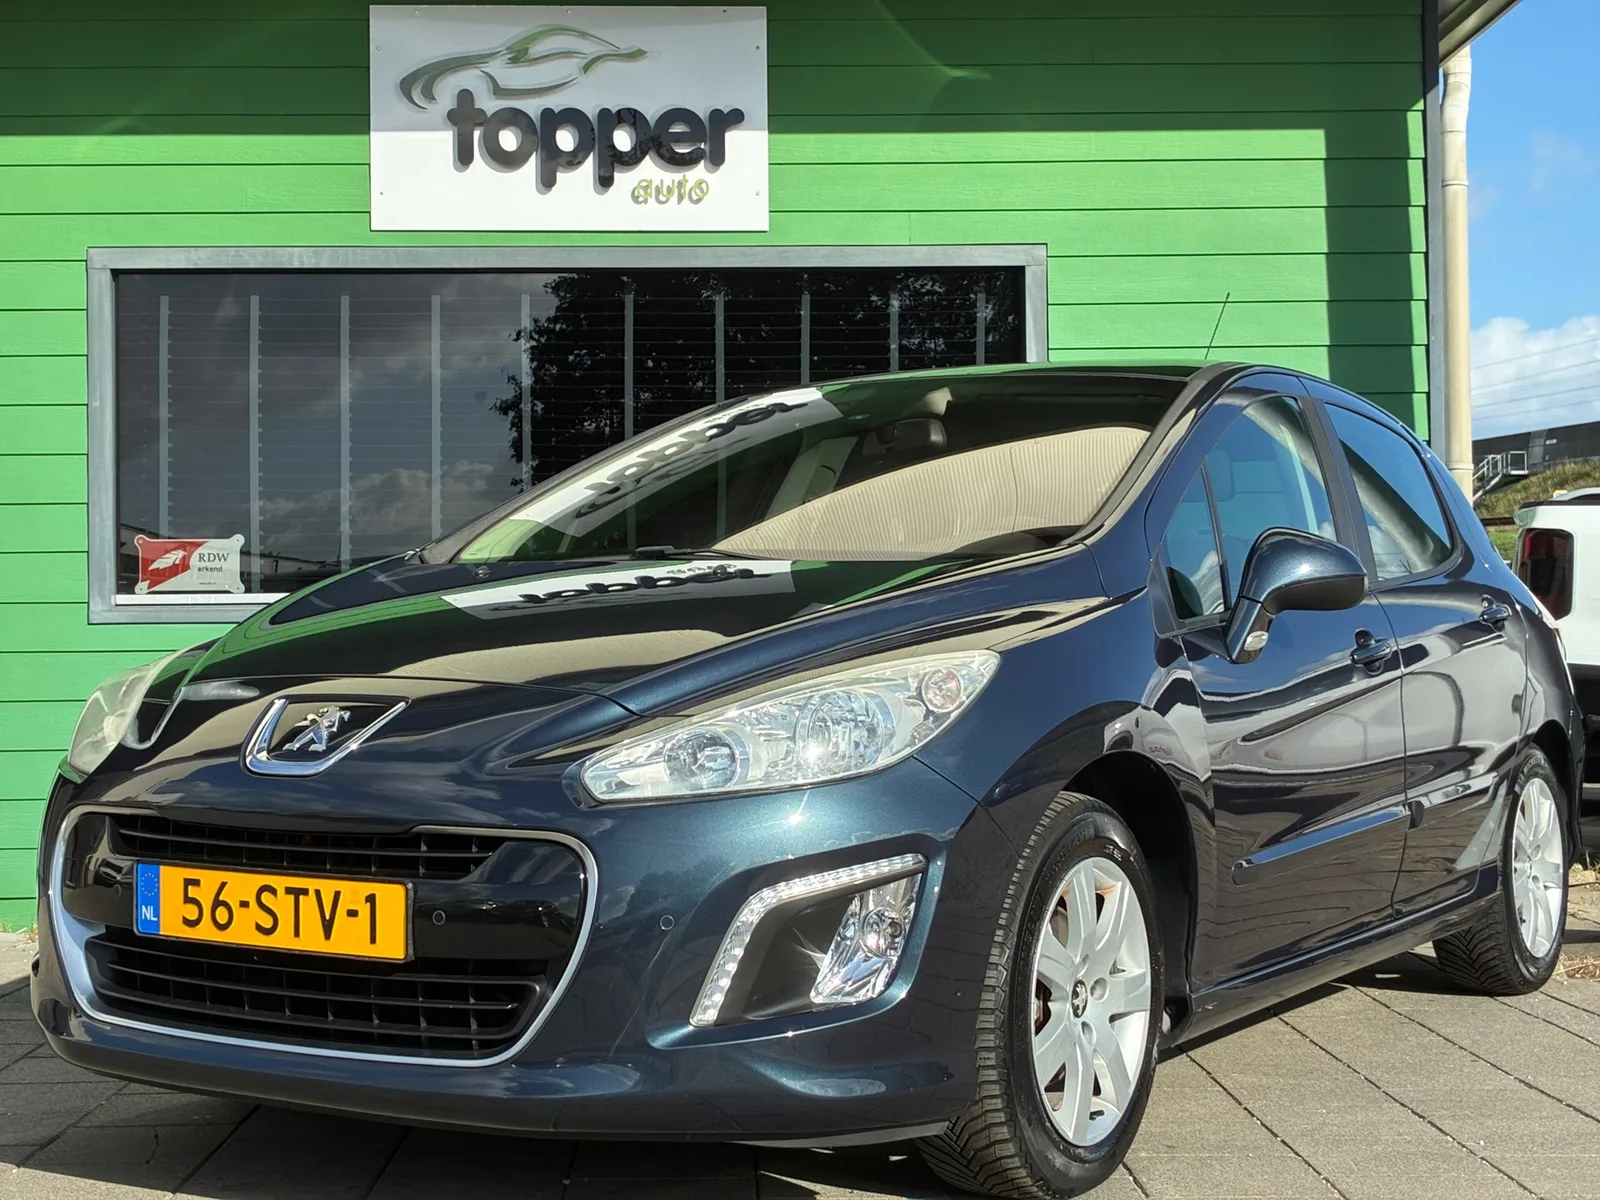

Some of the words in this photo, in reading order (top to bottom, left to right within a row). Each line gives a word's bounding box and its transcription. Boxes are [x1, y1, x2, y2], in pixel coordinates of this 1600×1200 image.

[446, 88, 745, 189] topper
[634, 174, 709, 202] auto
[198, 552, 230, 563] RDW
[197, 565, 223, 573] erkend
[141, 905, 158, 922] NL
[181, 877, 377, 945] 56-STV-1
